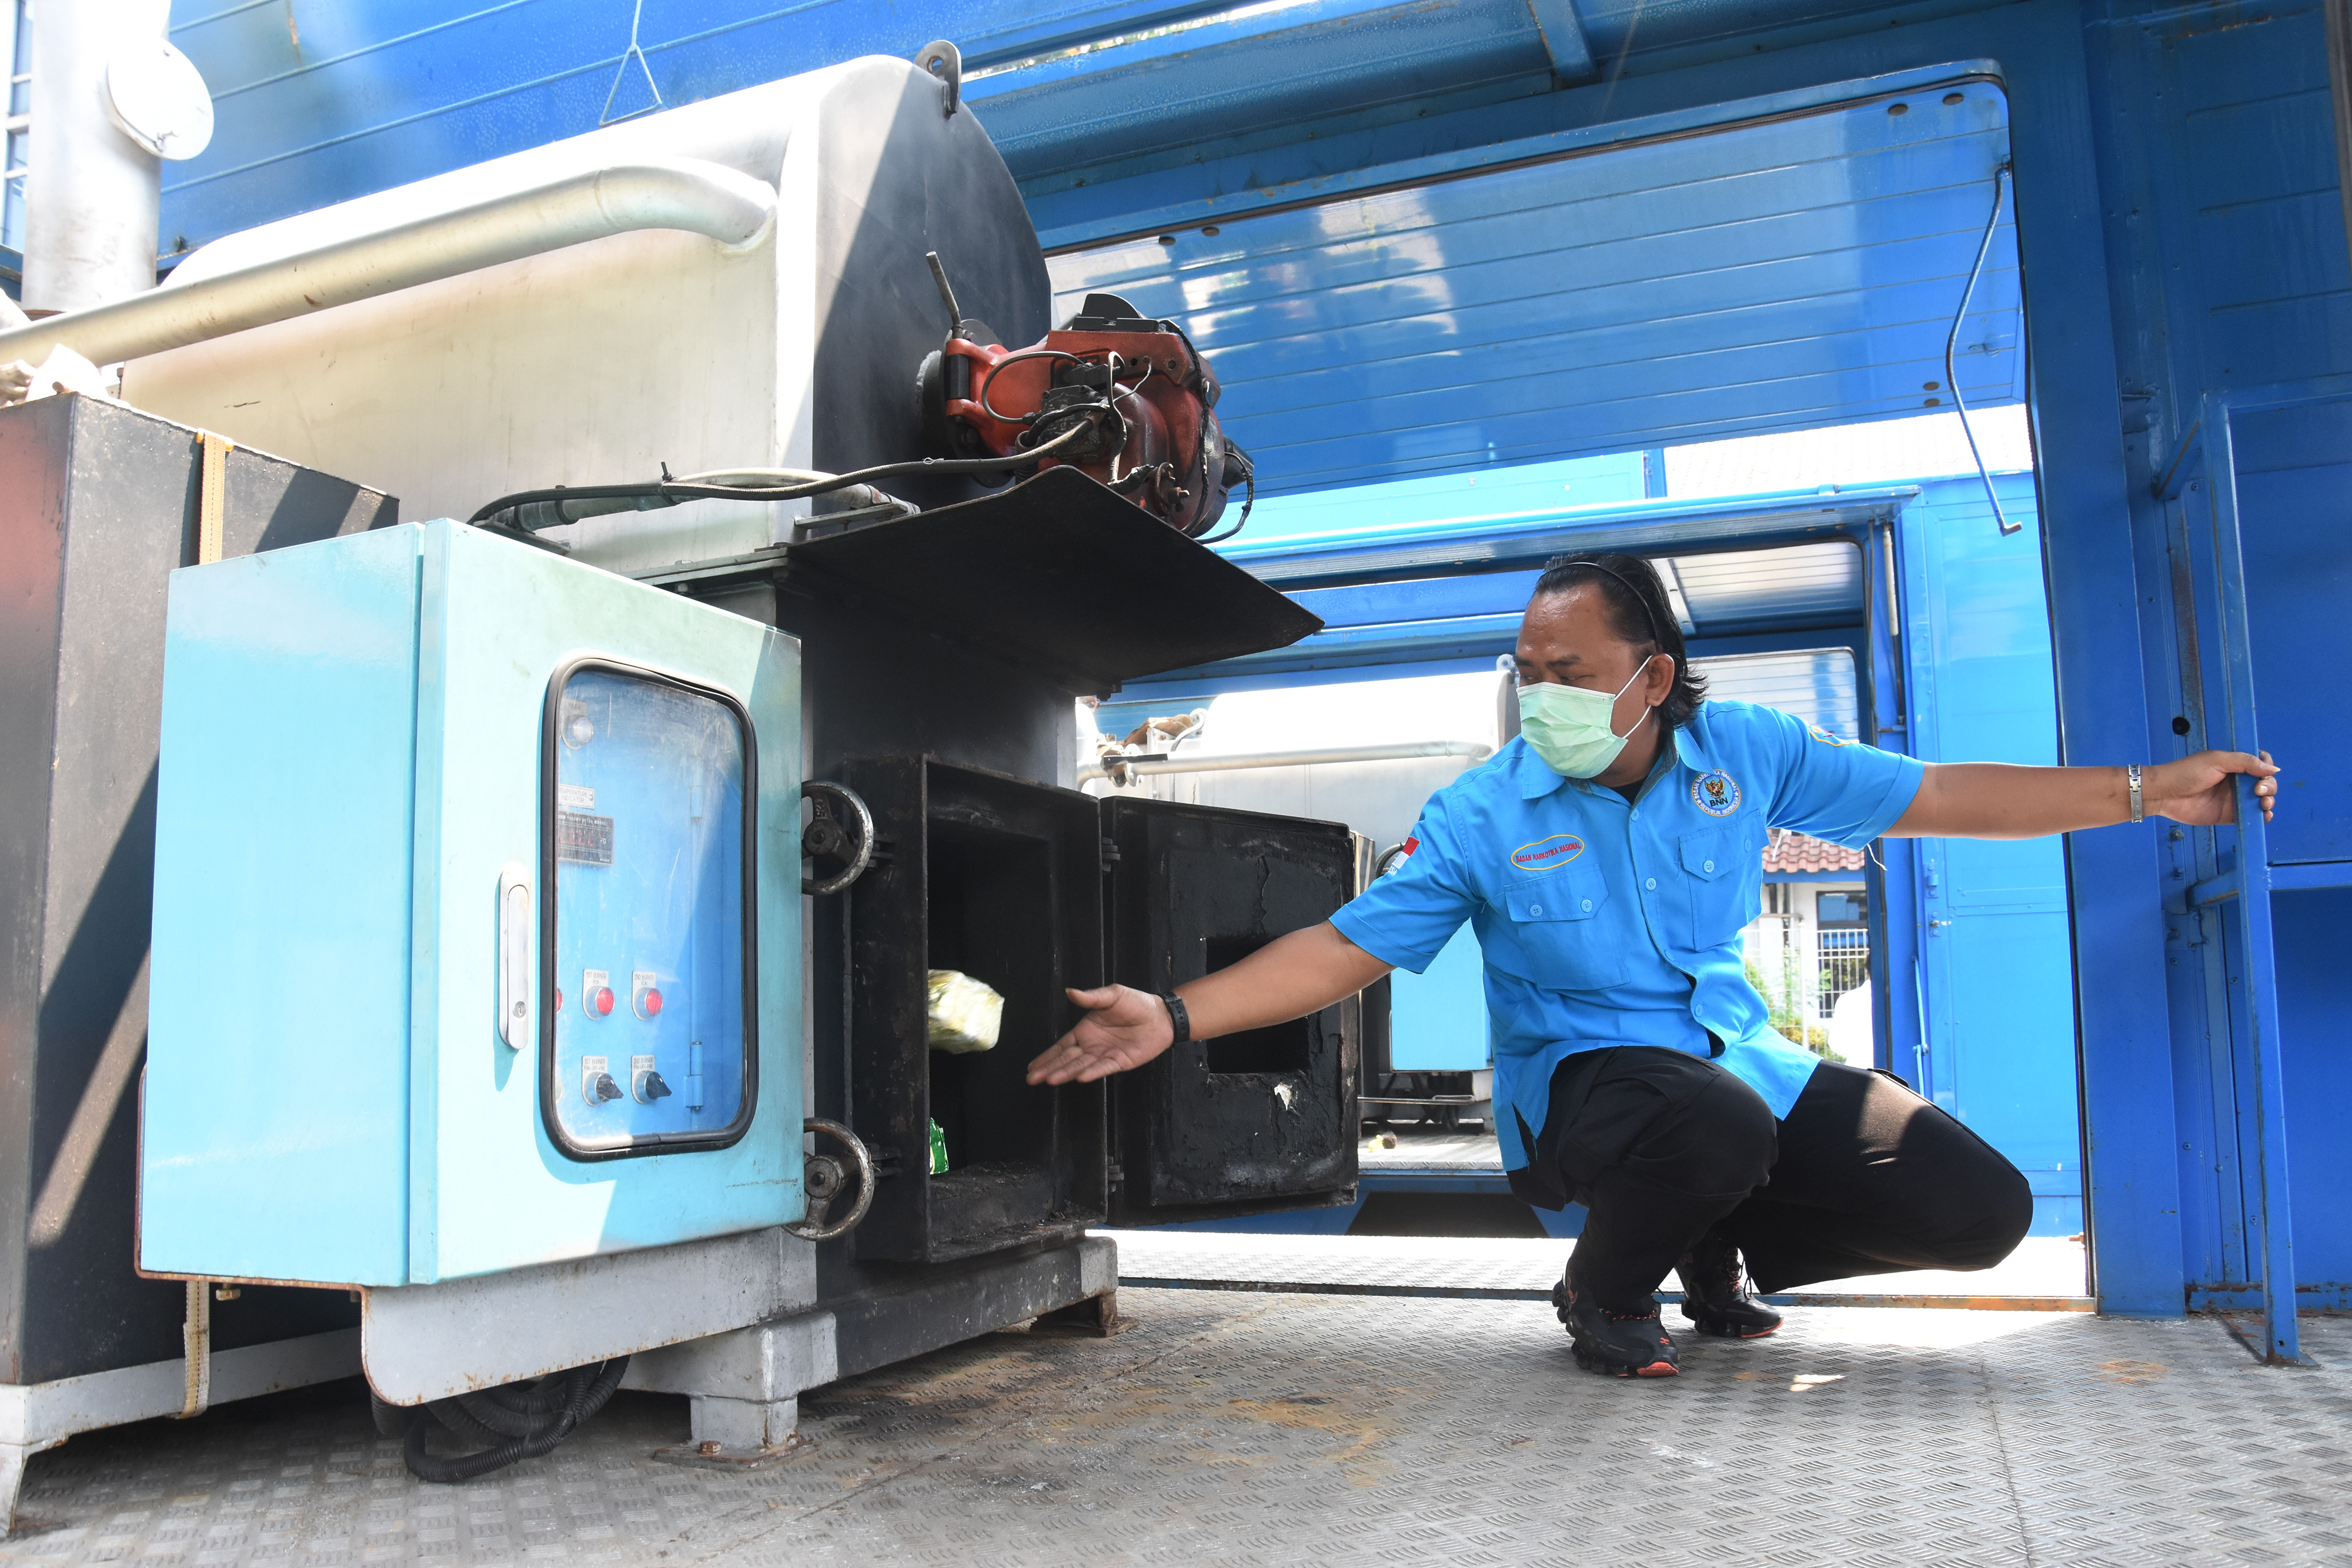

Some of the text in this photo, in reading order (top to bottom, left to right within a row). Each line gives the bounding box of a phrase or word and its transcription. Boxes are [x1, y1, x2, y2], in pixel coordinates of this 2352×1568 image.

[1721, 771, 1738, 791] NASIONAL
[1700, 803, 1722, 815] REPUBLIK
[1709, 797, 1729, 807] BNN
[1516, 841, 1581, 862] BADAN NARKOTIKA NASIONAL
